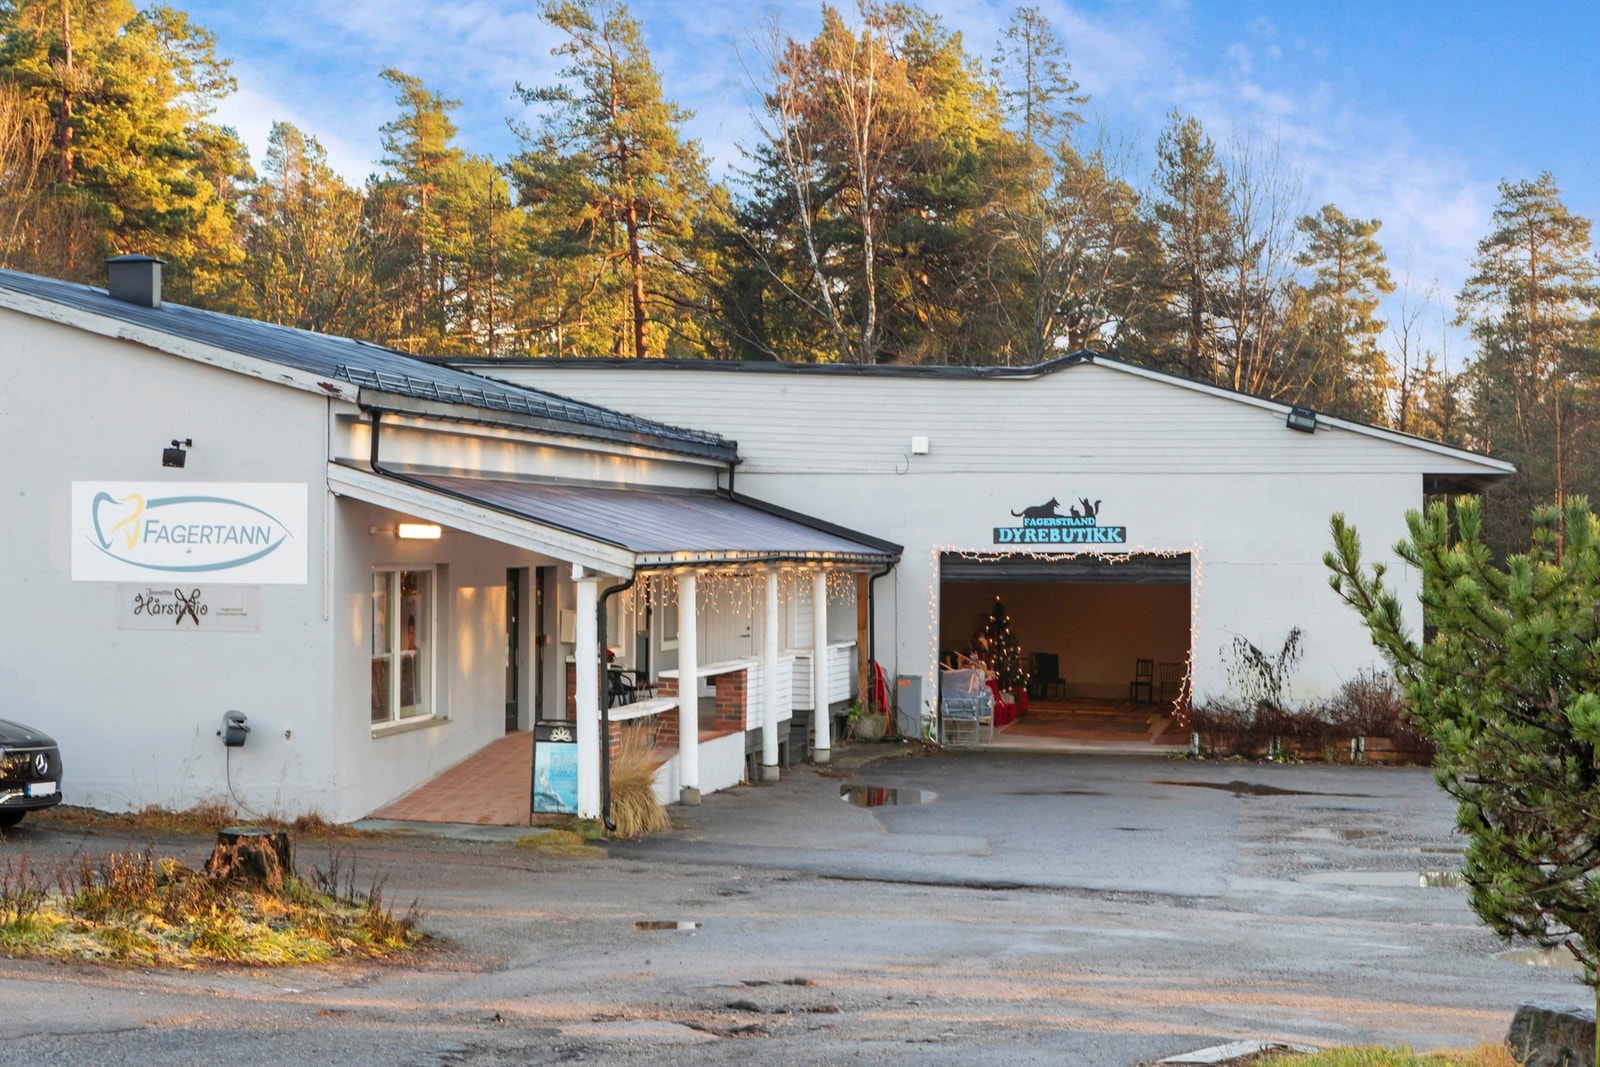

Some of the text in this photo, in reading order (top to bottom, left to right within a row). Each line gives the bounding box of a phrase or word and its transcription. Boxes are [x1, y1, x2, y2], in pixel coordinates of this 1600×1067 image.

[1024, 517, 1096, 526] FAGERSTRAND
[143, 520, 271, 544] FAGERTANN
[998, 528, 1123, 543] DYREBUTIKK
